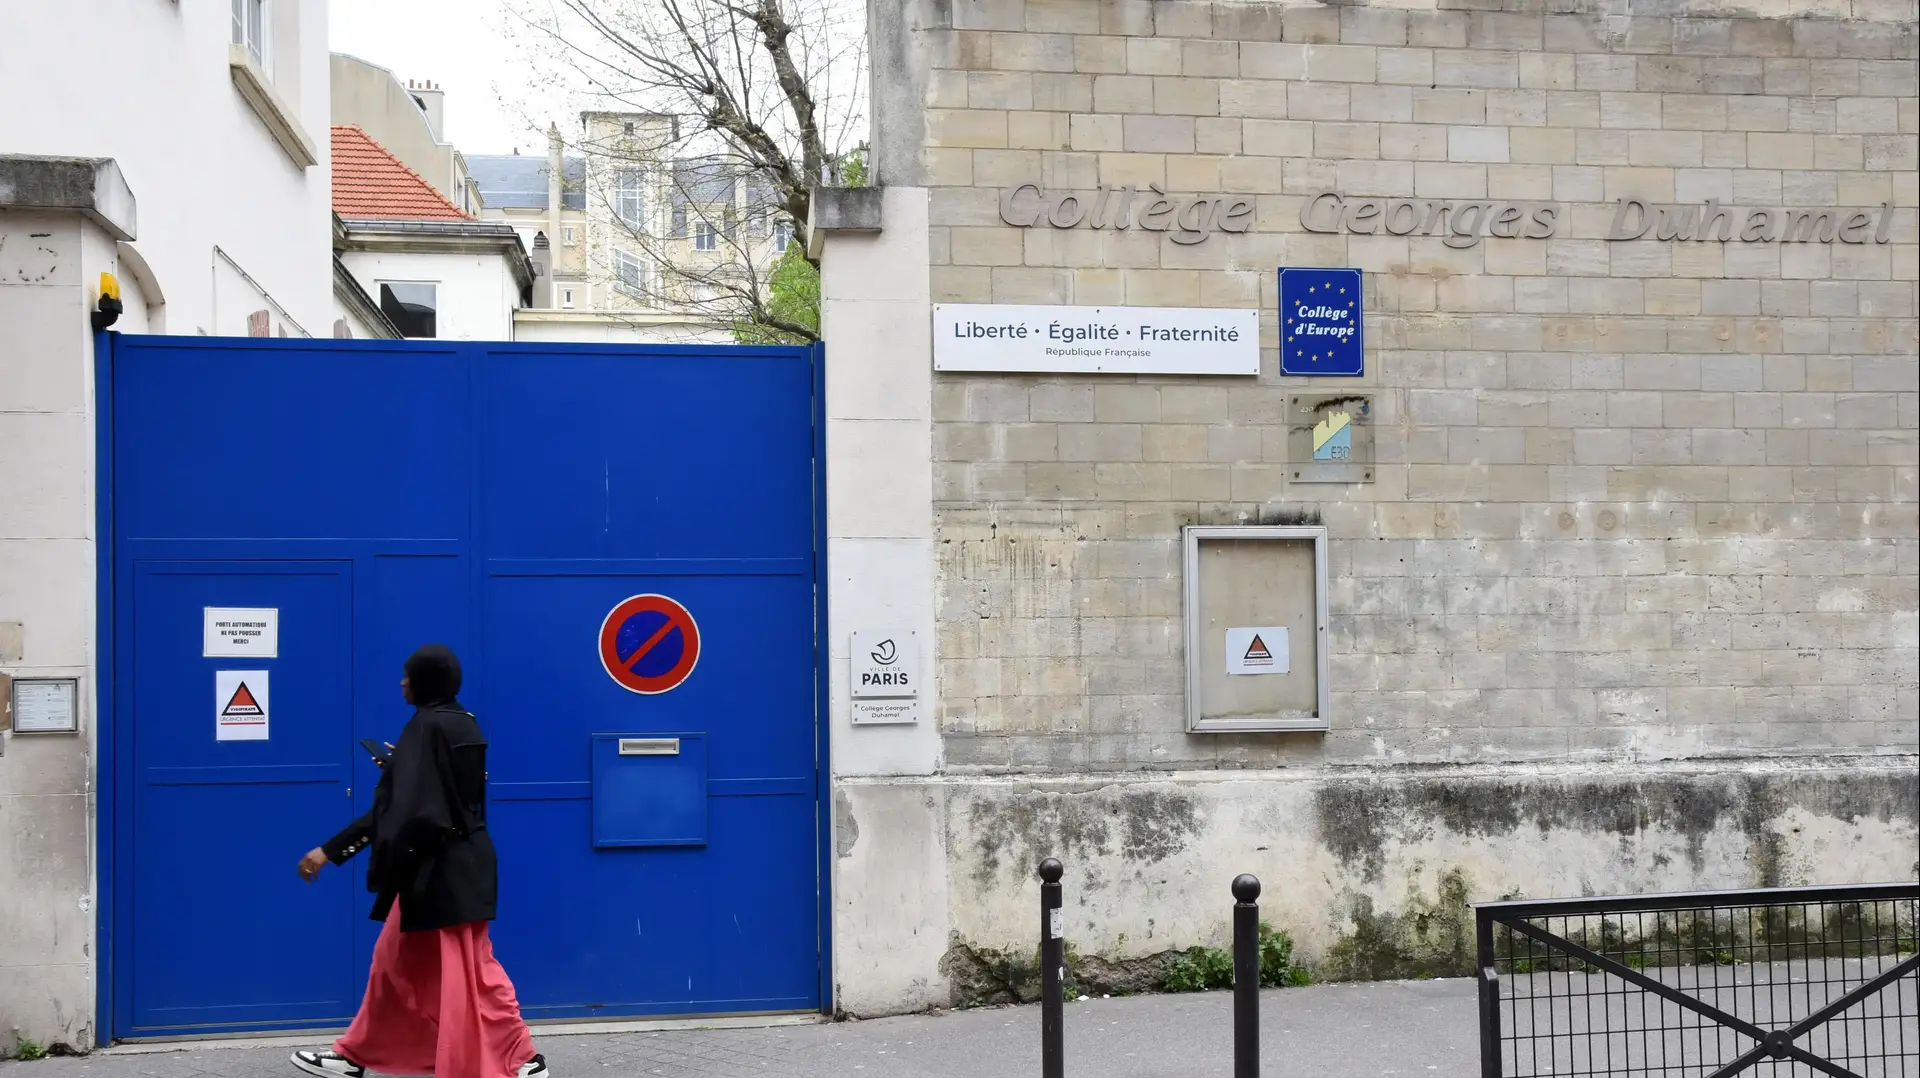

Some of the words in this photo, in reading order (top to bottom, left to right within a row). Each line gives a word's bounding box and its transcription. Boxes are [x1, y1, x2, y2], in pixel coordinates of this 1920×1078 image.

[999, 183, 1253, 245] Collège
[1299, 192, 1561, 249] Georges
[1605, 197, 1896, 244] Duhamel
[1298, 305, 1348, 319] Collège
[954, 321, 1028, 339] Liberté
[1048, 320, 1119, 344] Égalité
[1139, 325, 1239, 342] Fraternité
[1295, 323, 1354, 339] d'Europe
[1045, 347, 1102, 357] République
[1104, 348, 1151, 358] Française
[862, 672, 908, 685] PARIS
